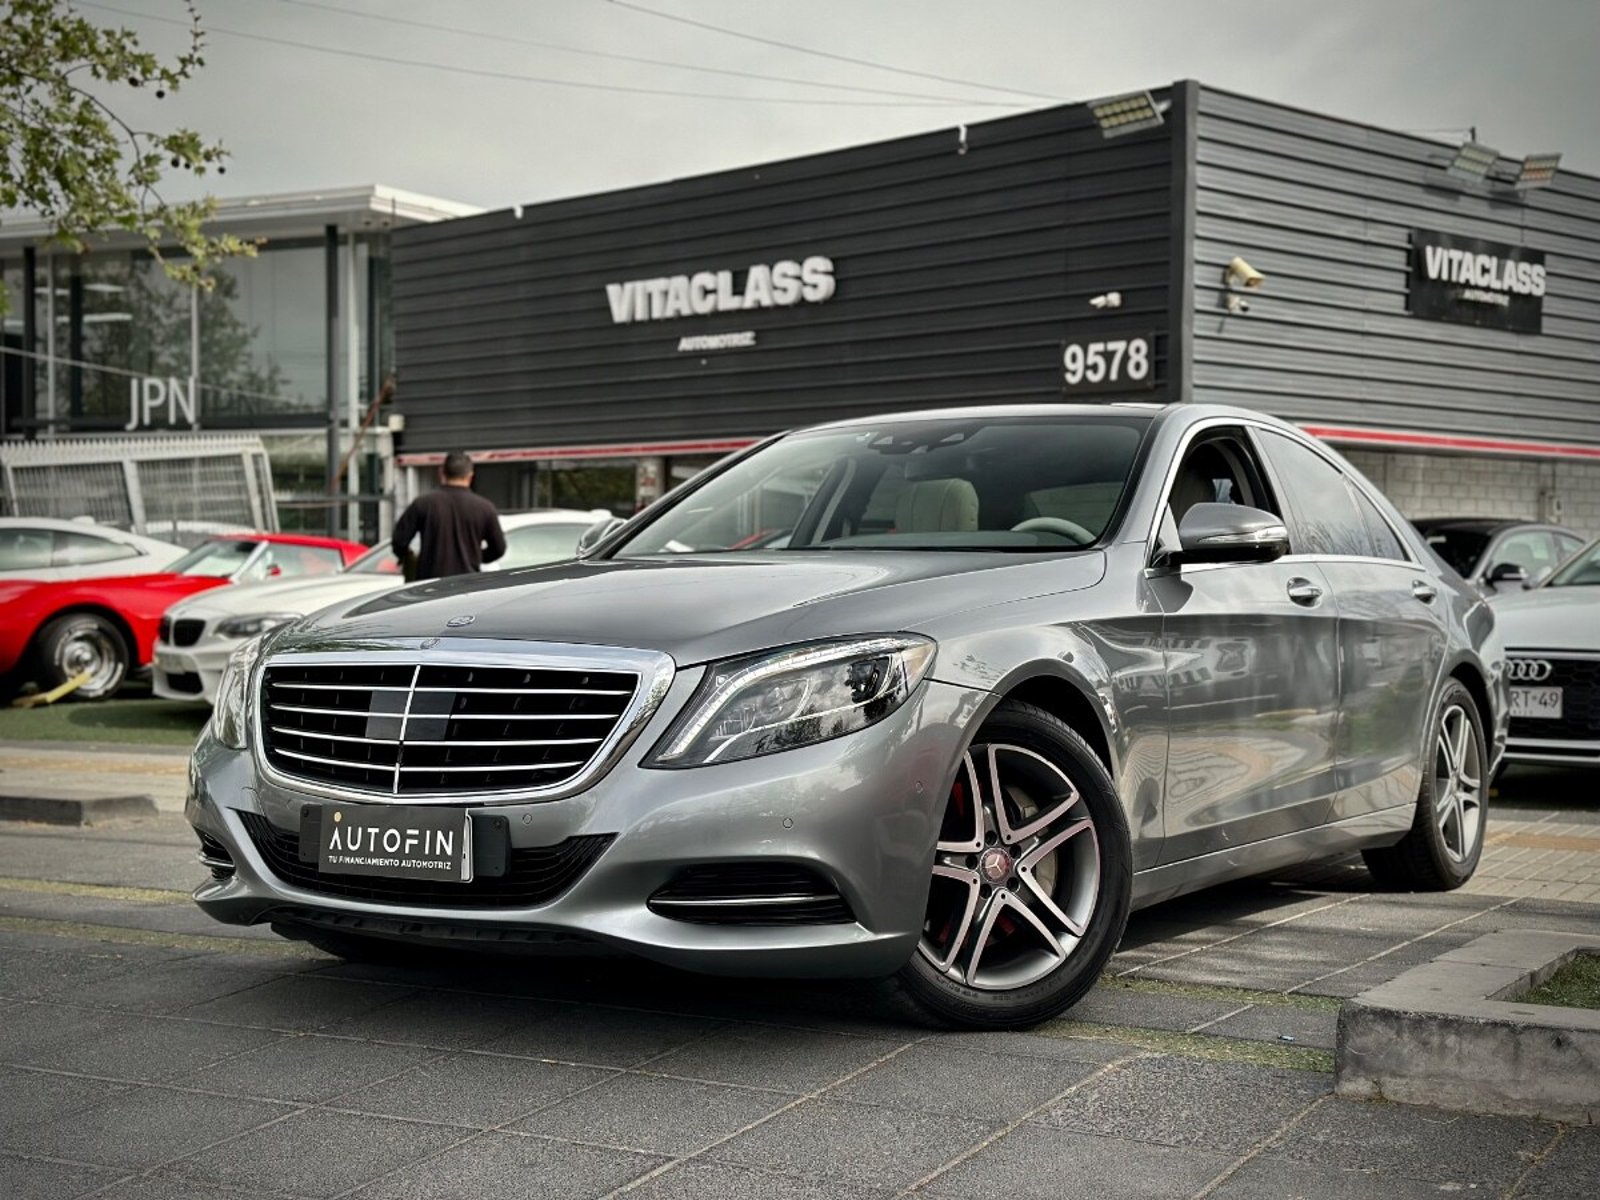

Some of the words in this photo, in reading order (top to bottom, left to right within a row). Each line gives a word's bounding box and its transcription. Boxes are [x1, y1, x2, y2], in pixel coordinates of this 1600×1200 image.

[605, 256, 836, 324] VITACLASS
[1425, 245, 1546, 297] VITACLASS
[1063, 338, 1149, 385] 9578
[125, 377, 195, 431] JPN
[328, 826, 454, 857] AUTOFIN
[328, 855, 338, 864] TU
[339, 855, 400, 867] FINANCIAMIENTO
[401, 859, 452, 870] AUTOMOTRIZ
